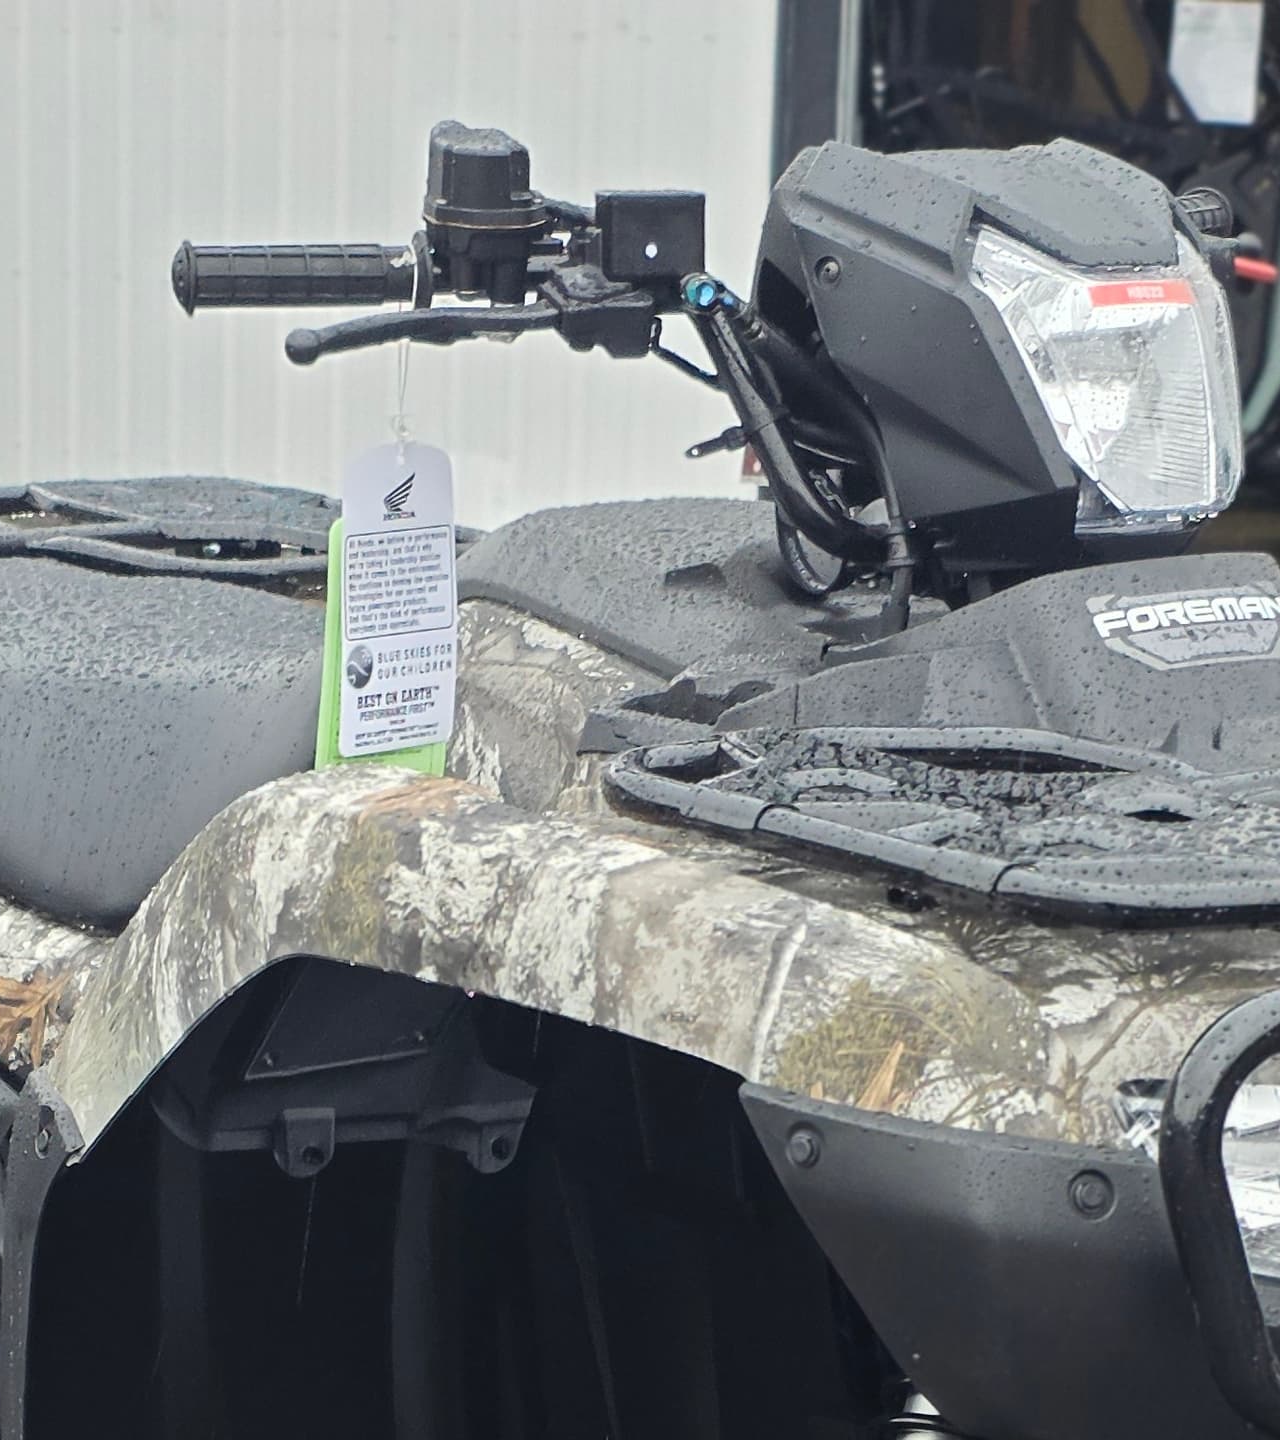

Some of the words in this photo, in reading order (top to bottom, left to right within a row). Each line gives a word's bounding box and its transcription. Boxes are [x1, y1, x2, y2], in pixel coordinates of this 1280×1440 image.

[378, 650, 400, 664] BLUE
[404, 646, 431, 660] SKIES
[434, 644, 452, 656] FOR
[378, 666, 397, 680] OUR
[401, 660, 452, 676] CHILDREN
[357, 694, 382, 709] BEST
[386, 692, 398, 705] ON
[360, 705, 407, 721] PERFORMANCE
